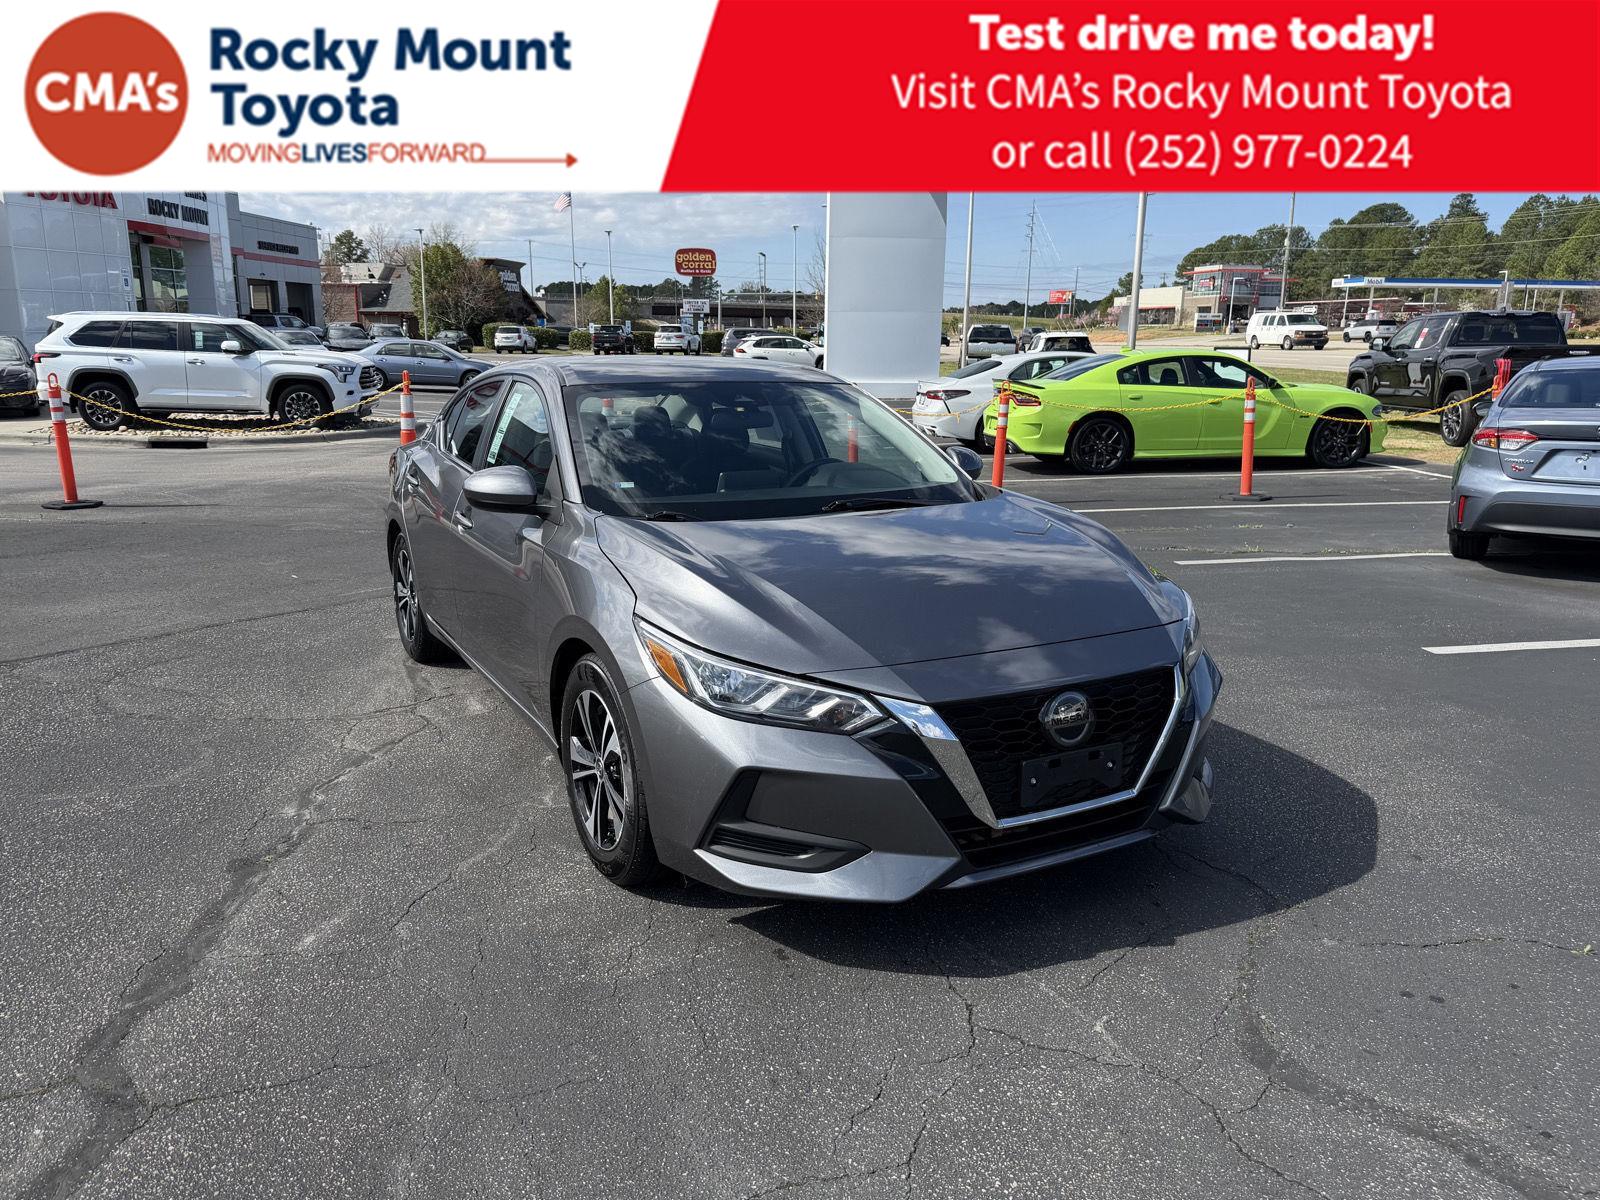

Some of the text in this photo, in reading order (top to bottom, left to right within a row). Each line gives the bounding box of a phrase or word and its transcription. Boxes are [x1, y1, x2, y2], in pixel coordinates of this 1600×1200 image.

[147, 198, 180, 219] ROCKY
[676, 252, 712, 263] golden
[682, 260, 716, 269] corral
[1050, 711, 1089, 727] NISSAN
